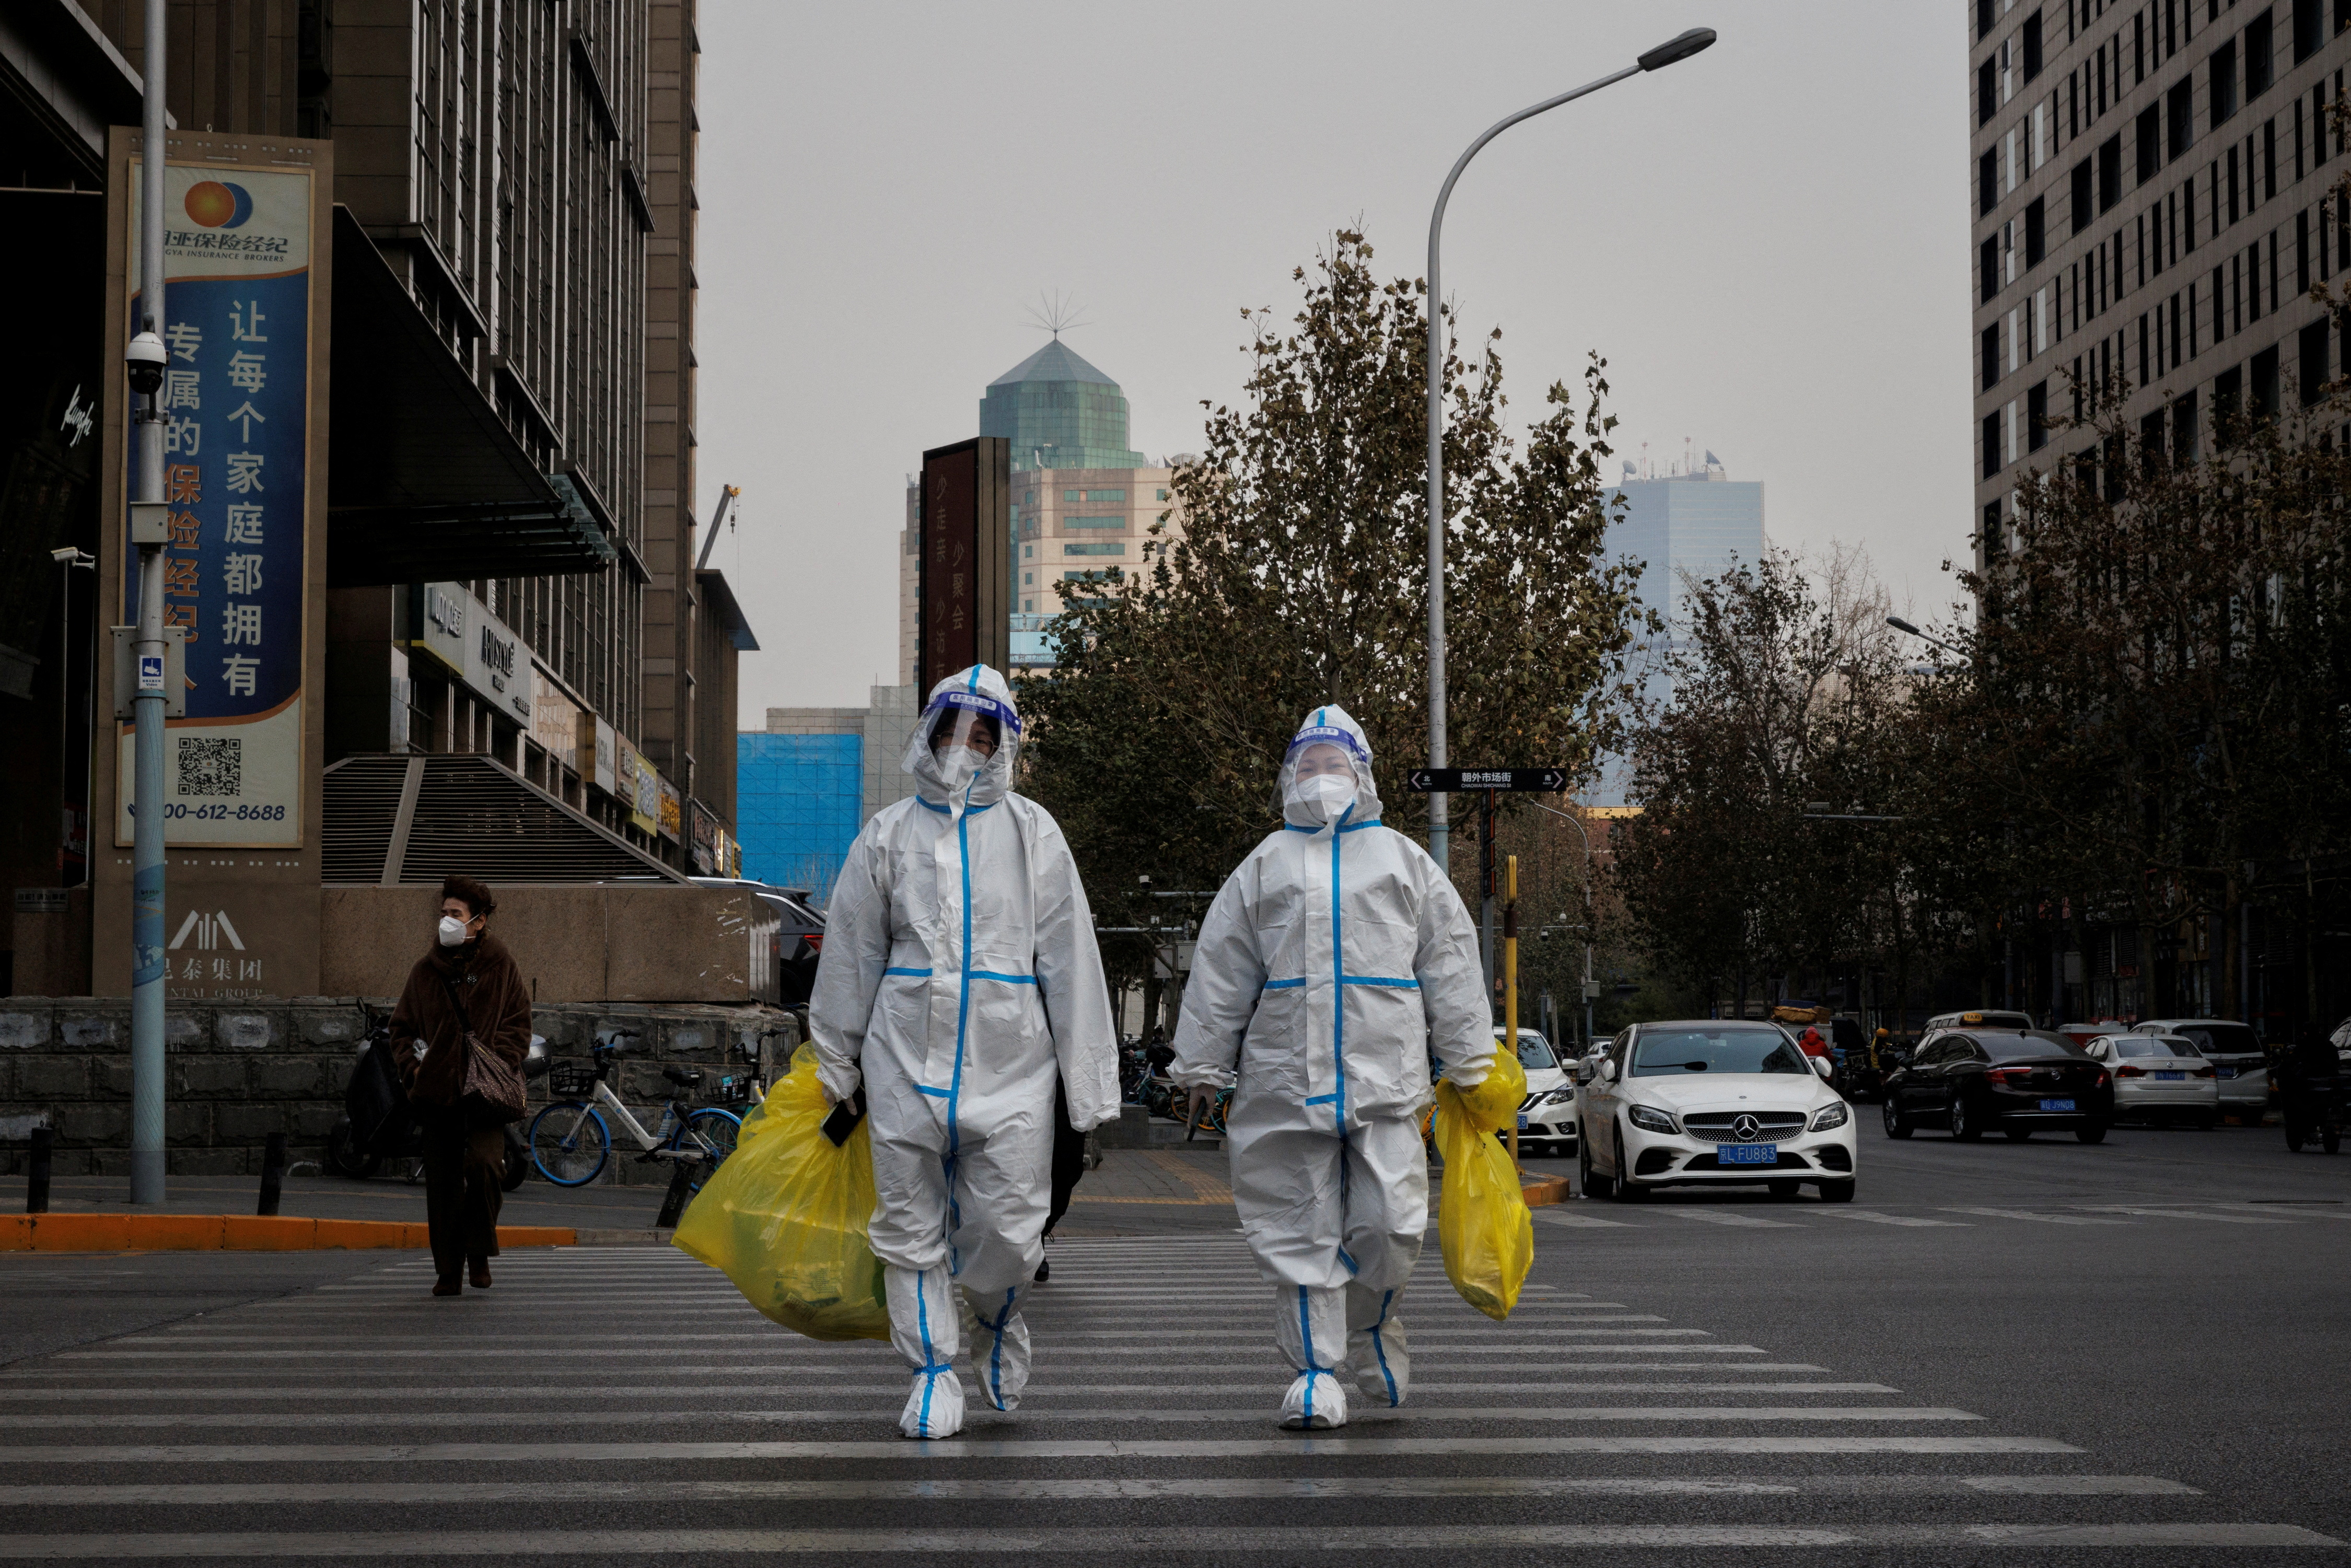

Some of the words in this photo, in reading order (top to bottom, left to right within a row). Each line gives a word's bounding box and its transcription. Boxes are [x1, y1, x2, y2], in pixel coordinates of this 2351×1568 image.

[187, 250, 239, 260] INSURANCE
[164, 322, 203, 691] 专属的保险经纪
[222, 299, 267, 696] 让每个家庭都拥有
[1461, 772, 1511, 783] 朝外市场街
[165, 803, 285, 821] 00-612-8688
